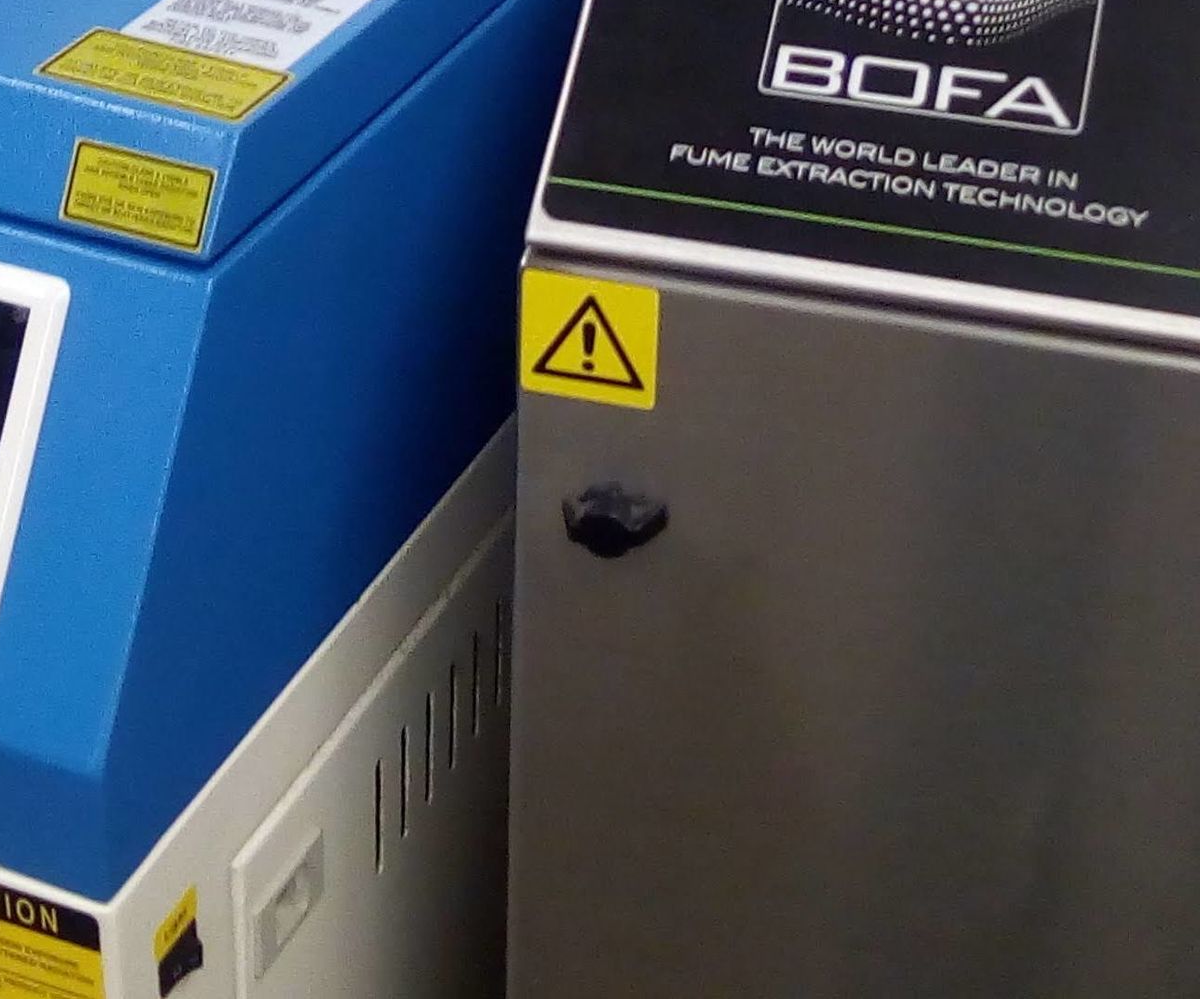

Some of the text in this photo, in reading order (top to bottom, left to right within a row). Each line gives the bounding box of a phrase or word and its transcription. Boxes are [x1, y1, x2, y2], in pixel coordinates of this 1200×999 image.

[770, 44, 1073, 128] BOFA
[669, 143, 1150, 229] FUME EXTRACTION TECHNOLOGY
[749, 126, 1080, 192] THE WORLD LEADER IN
